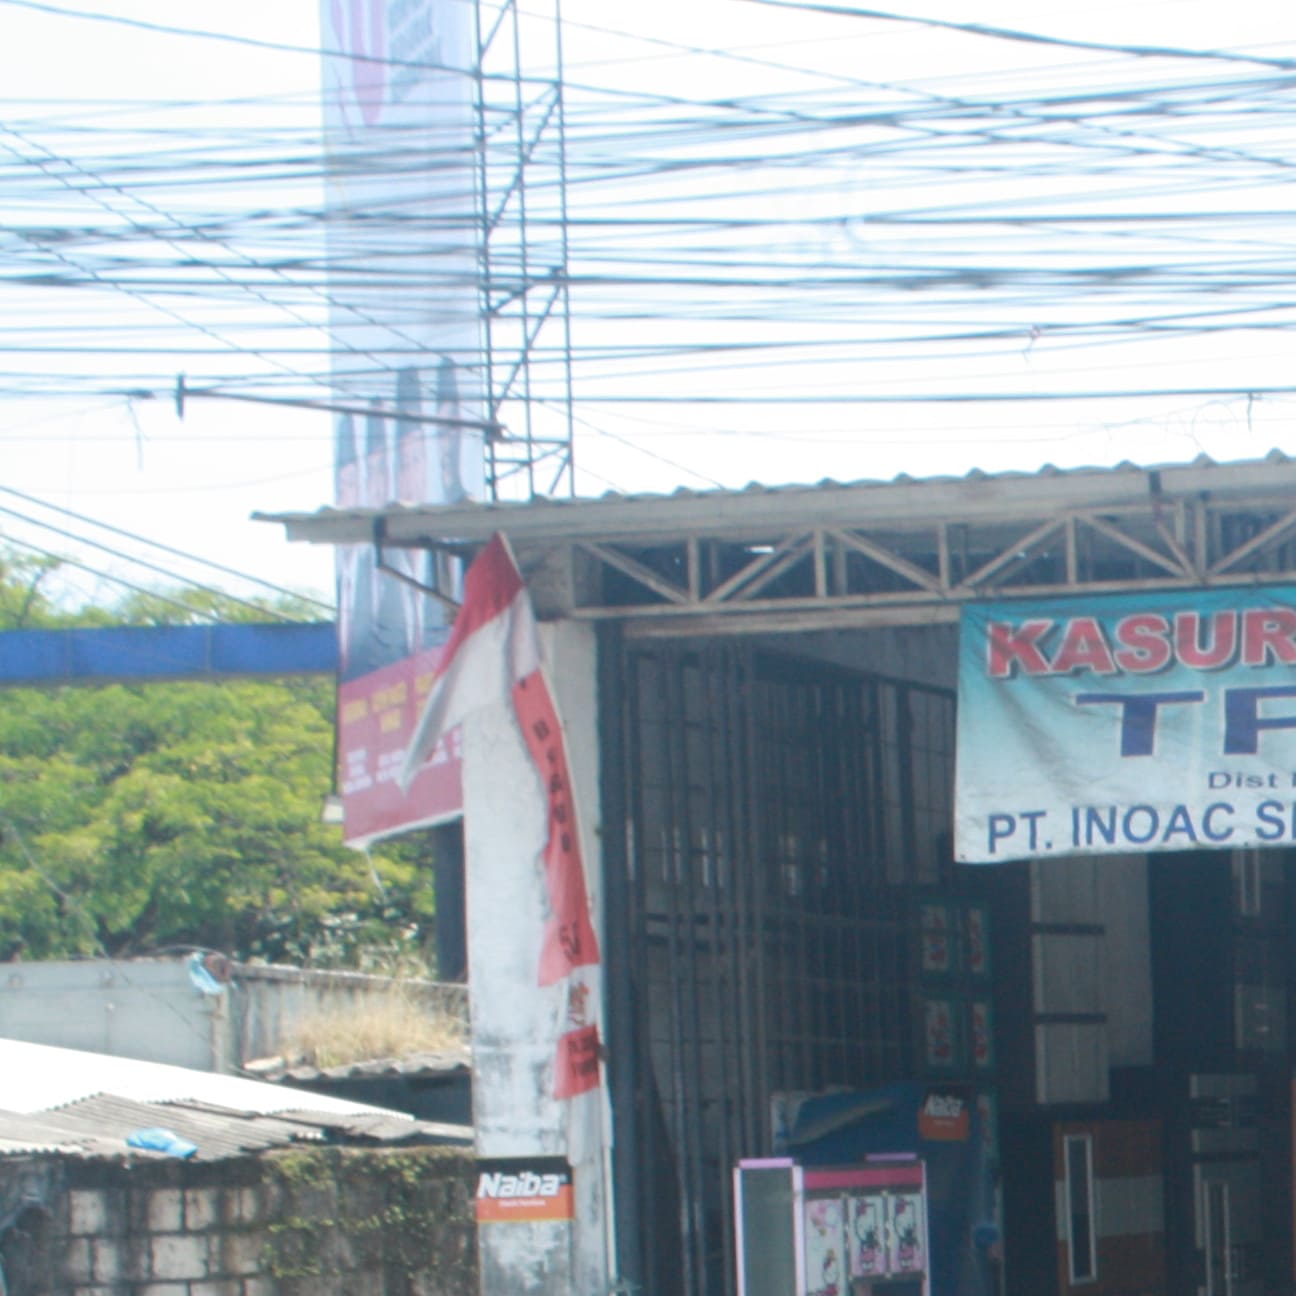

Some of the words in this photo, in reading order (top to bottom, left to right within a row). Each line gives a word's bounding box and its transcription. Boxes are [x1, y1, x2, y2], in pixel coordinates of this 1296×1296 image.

[1207, 771, 1280, 791] Dist
[986, 810, 1053, 854] PT.
[1071, 801, 1237, 849] INOAC
[476, 1171, 560, 1199] Naiba
